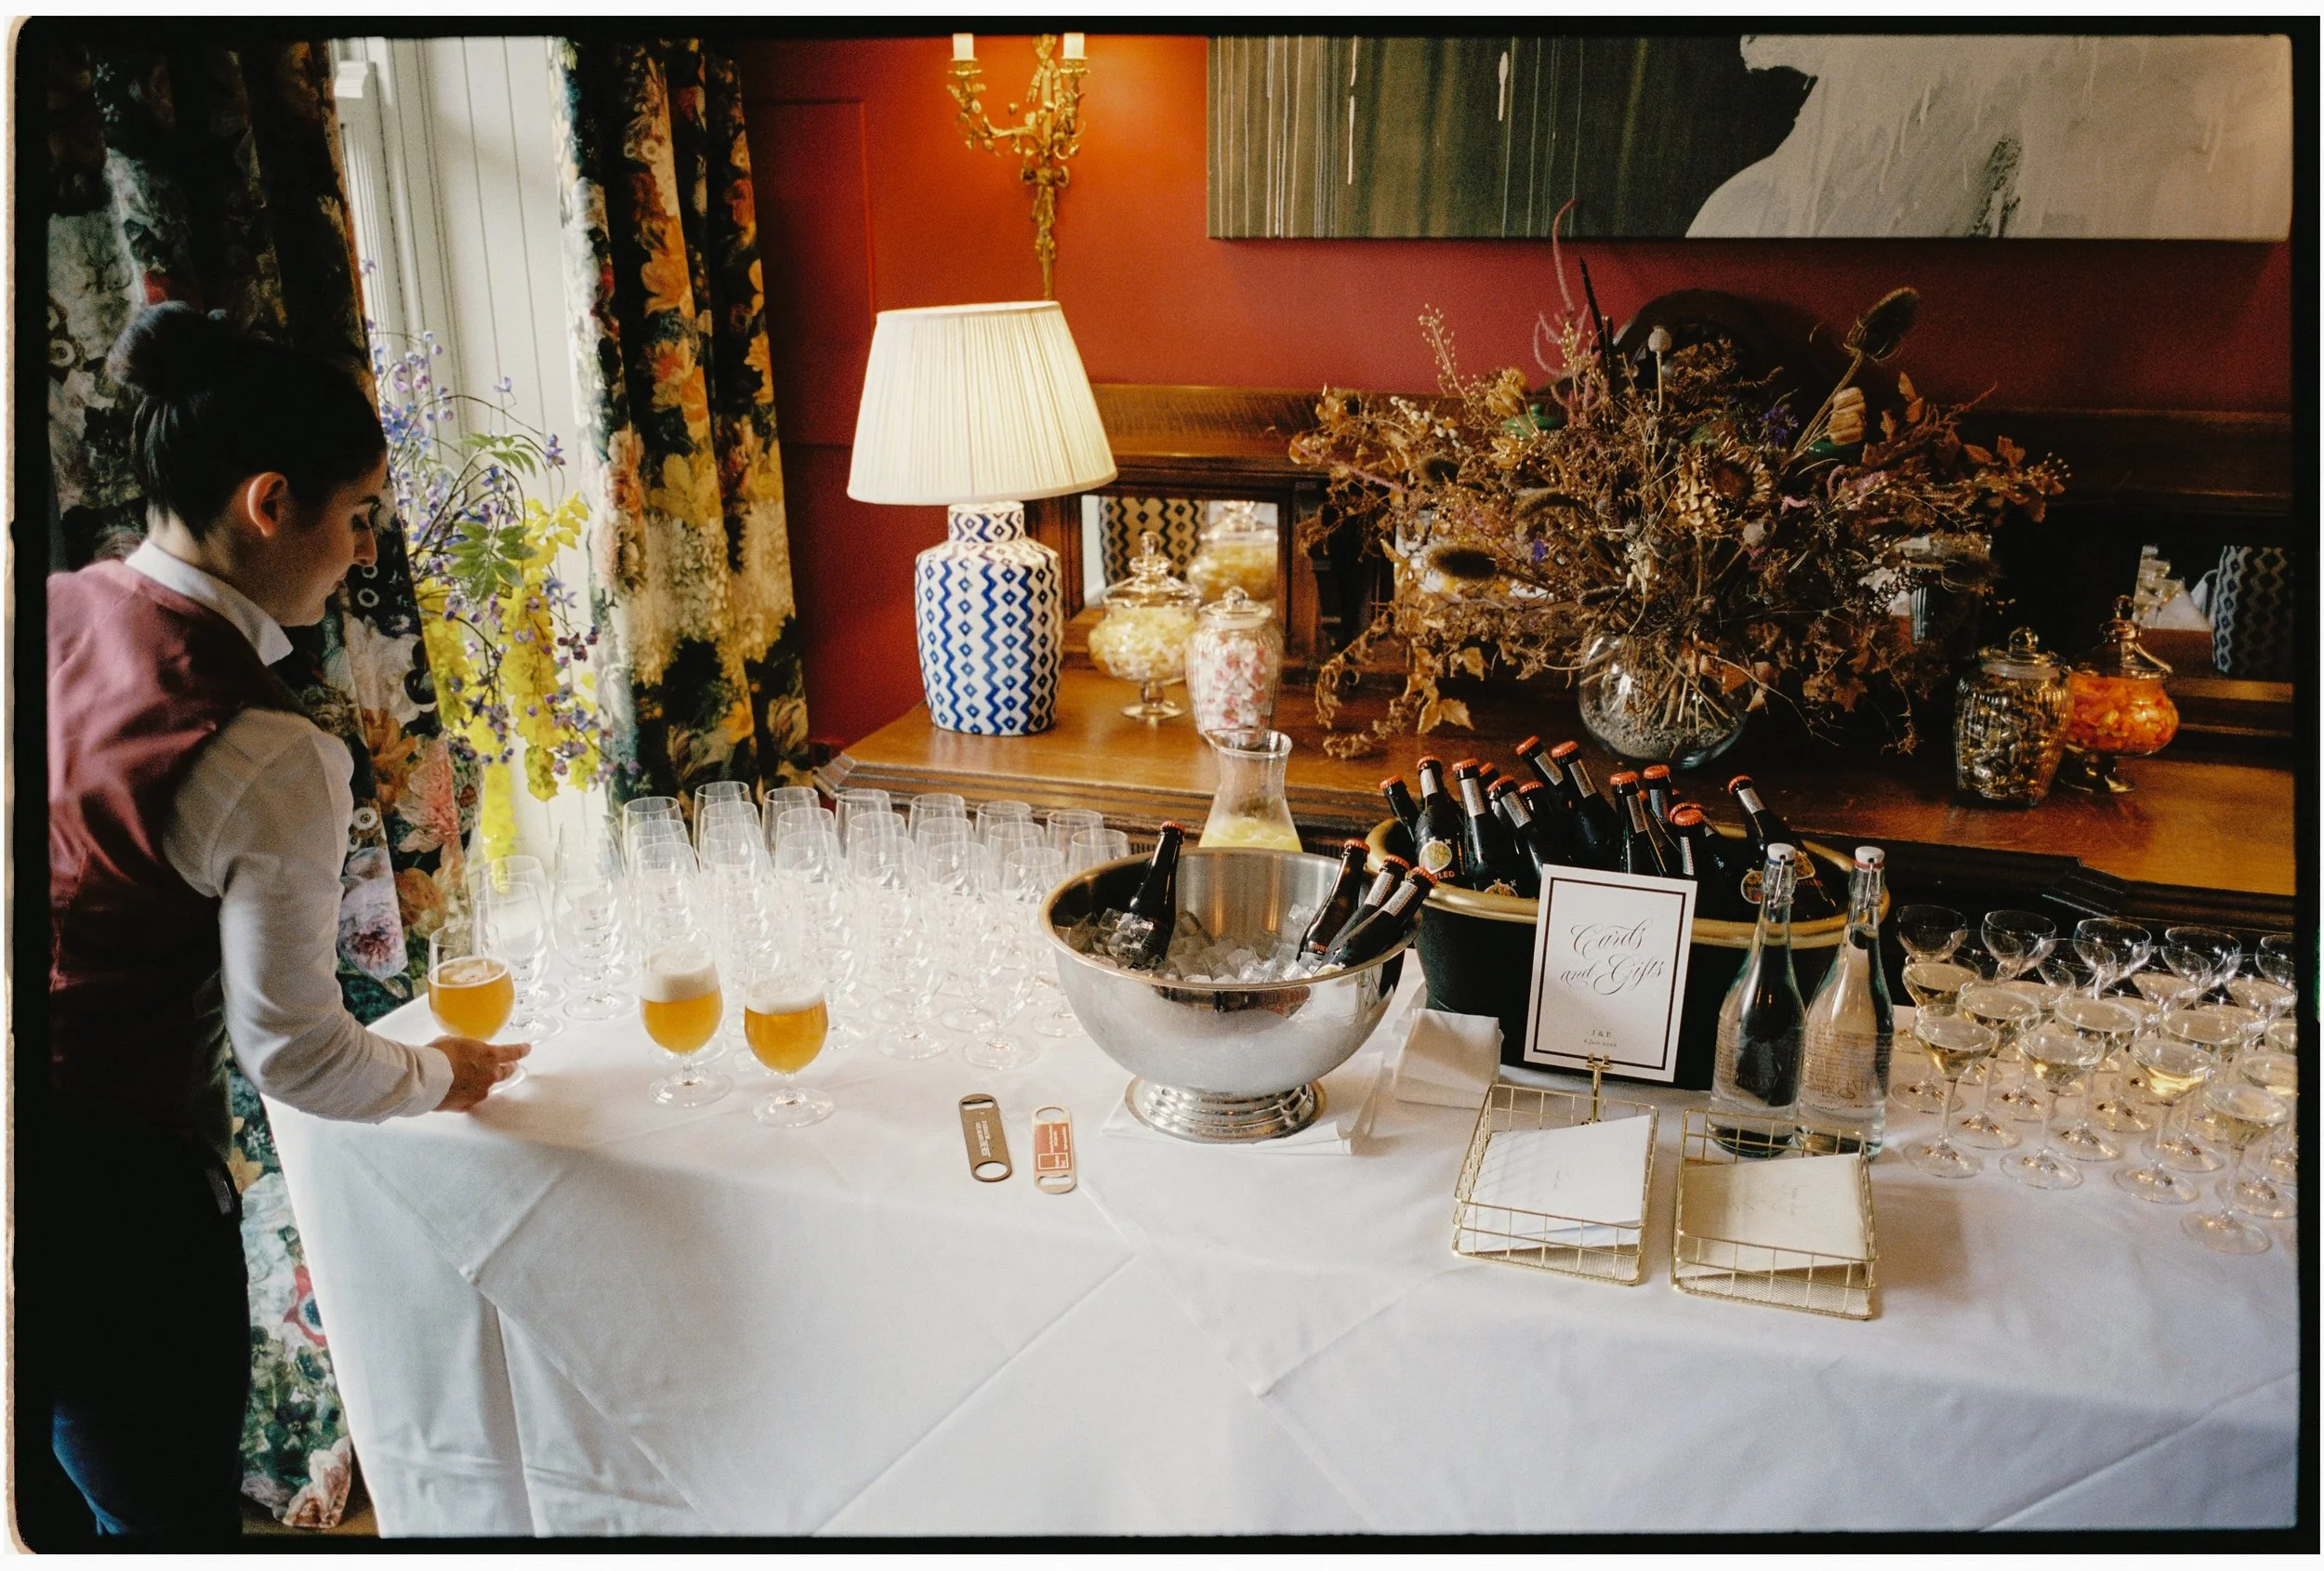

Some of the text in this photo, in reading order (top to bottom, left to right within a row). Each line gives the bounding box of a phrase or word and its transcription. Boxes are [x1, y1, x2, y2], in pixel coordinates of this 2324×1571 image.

[1570, 918, 1654, 959] Cards
[1560, 954, 1665, 996] and Gifts
